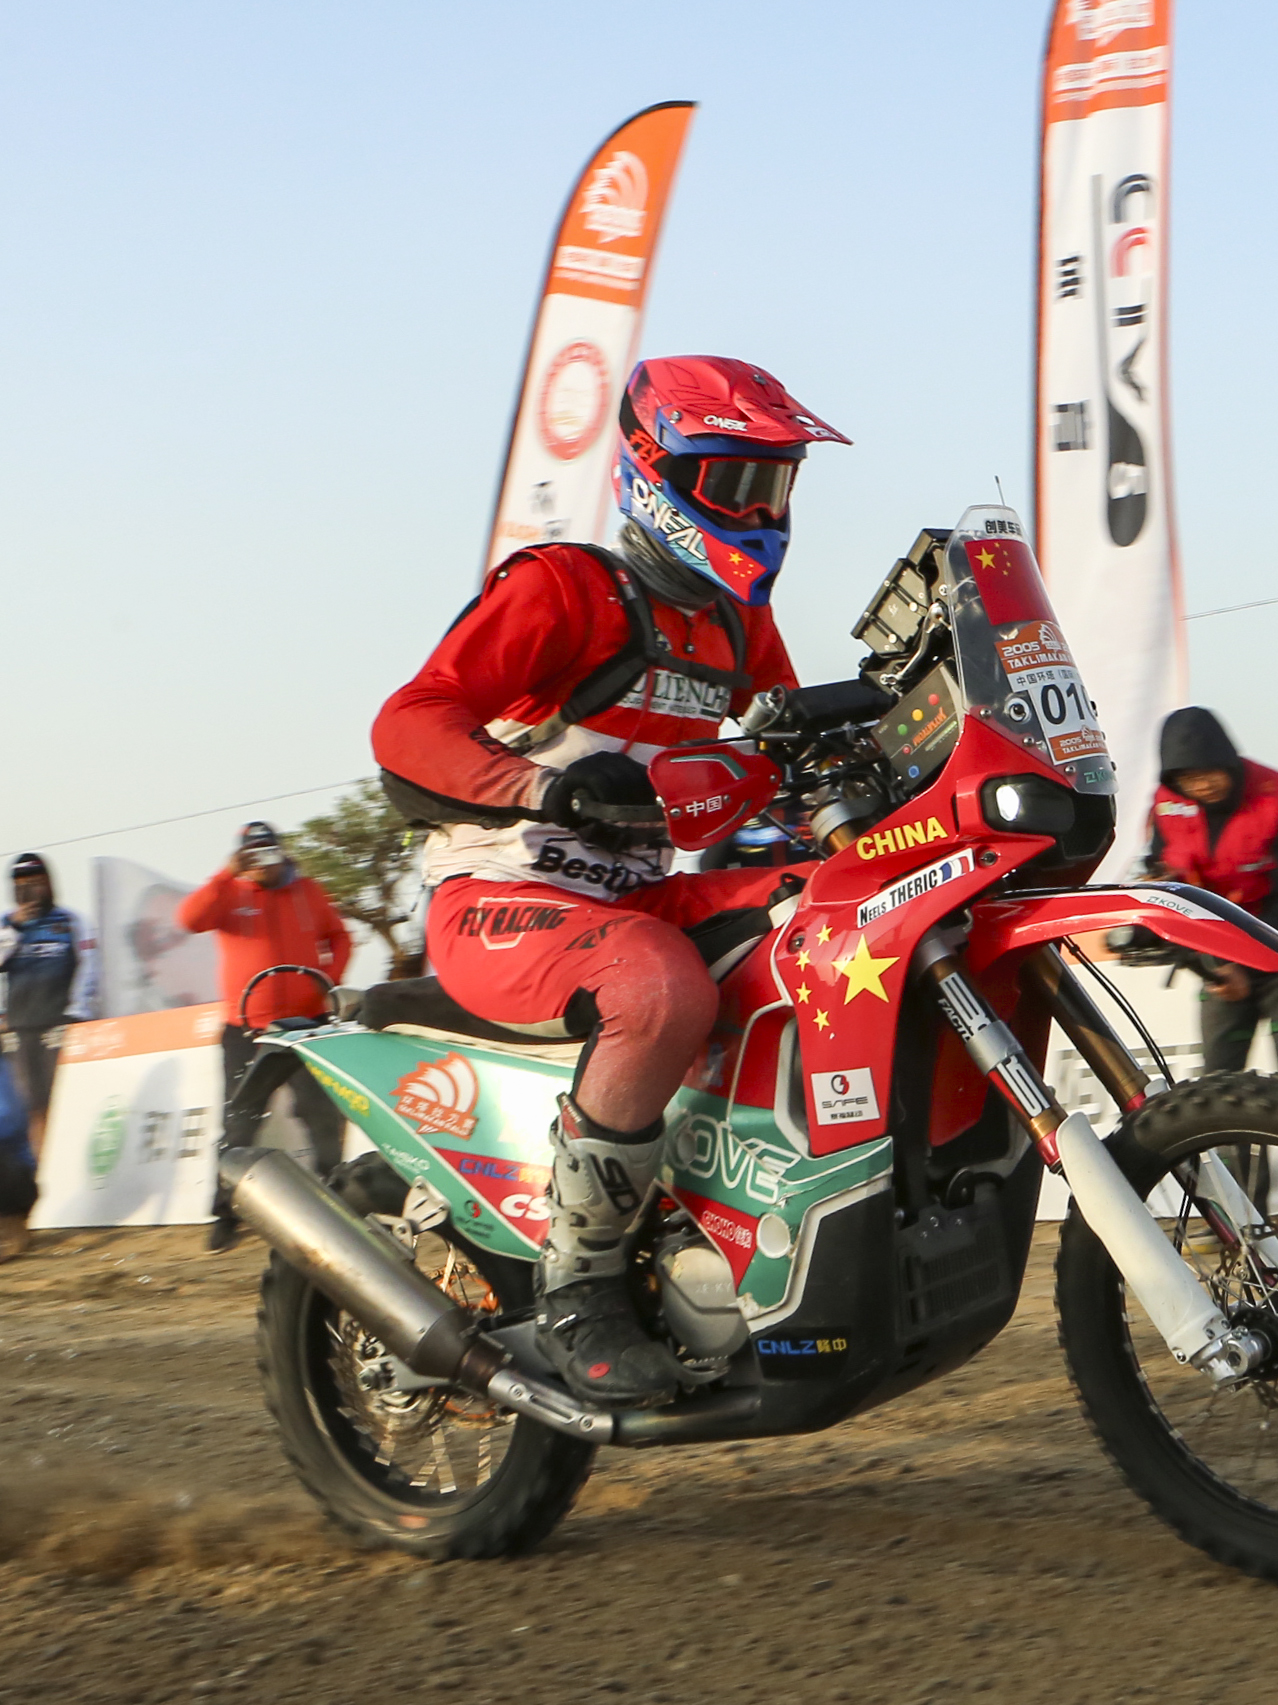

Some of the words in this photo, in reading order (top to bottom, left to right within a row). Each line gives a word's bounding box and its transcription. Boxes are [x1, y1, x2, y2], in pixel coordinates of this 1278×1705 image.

[1002, 641, 1041, 657] 2005
[686, 796, 722, 817] 中国
[856, 816, 949, 861] CHINA
[889, 868, 938, 908] THERIC
